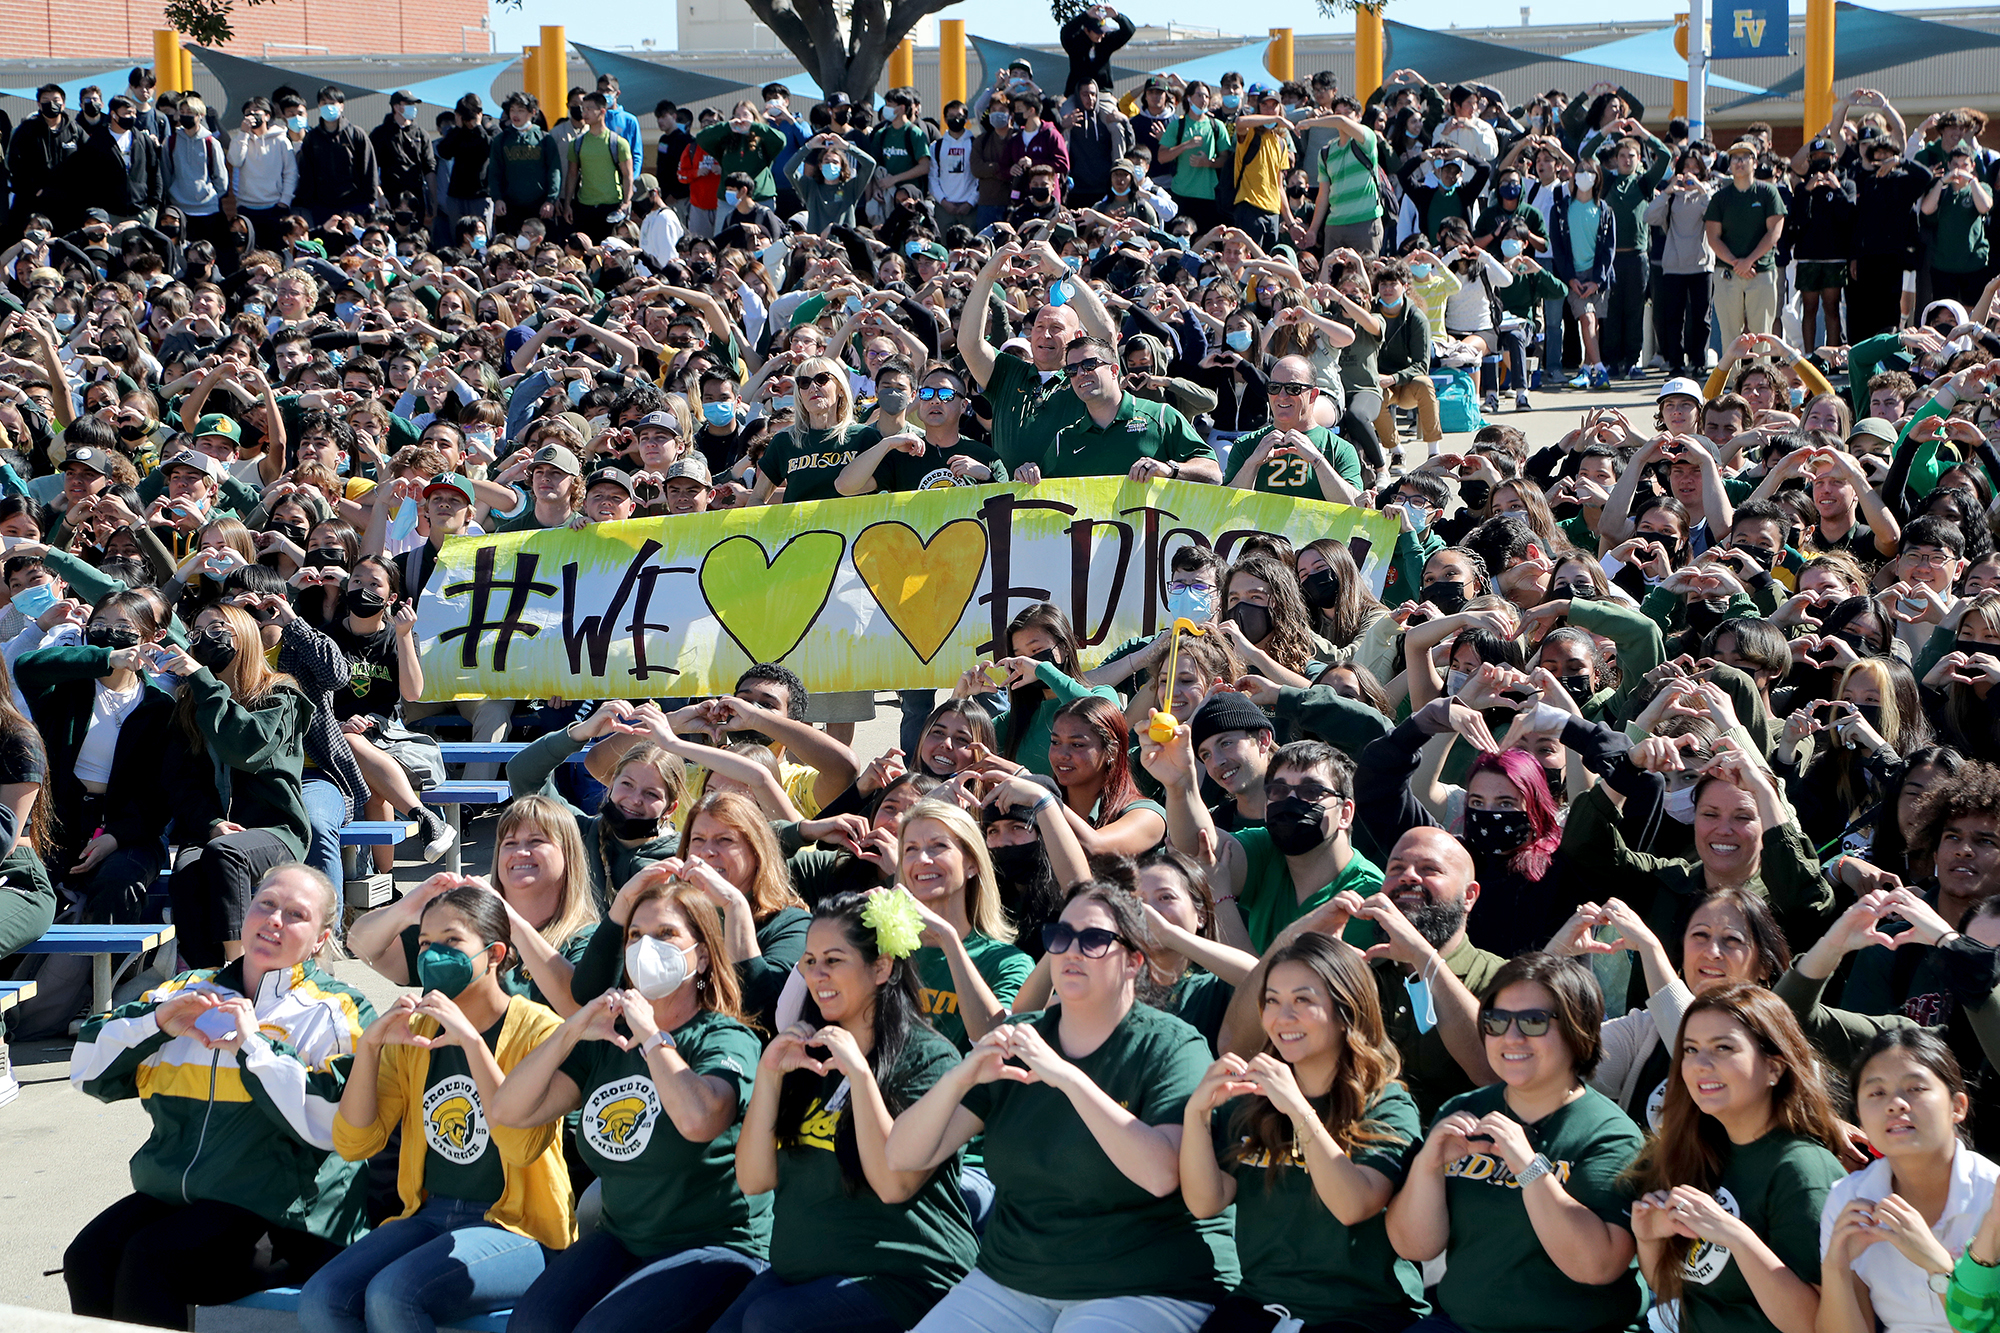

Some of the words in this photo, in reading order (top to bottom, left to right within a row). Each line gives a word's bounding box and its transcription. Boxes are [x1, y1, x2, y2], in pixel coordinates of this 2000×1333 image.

[1733, 9, 1766, 48] FV
[503, 145, 542, 161] VANS
[1268, 459, 1308, 487] 23
[423, 1082, 460, 1111] PROUD
[461, 1082, 472, 1093] TO
[592, 1082, 633, 1107] PROUD
[635, 1082, 649, 1094] TO
[432, 1137, 481, 1160] CHARGER
[590, 1135, 642, 1155] CHARGER
